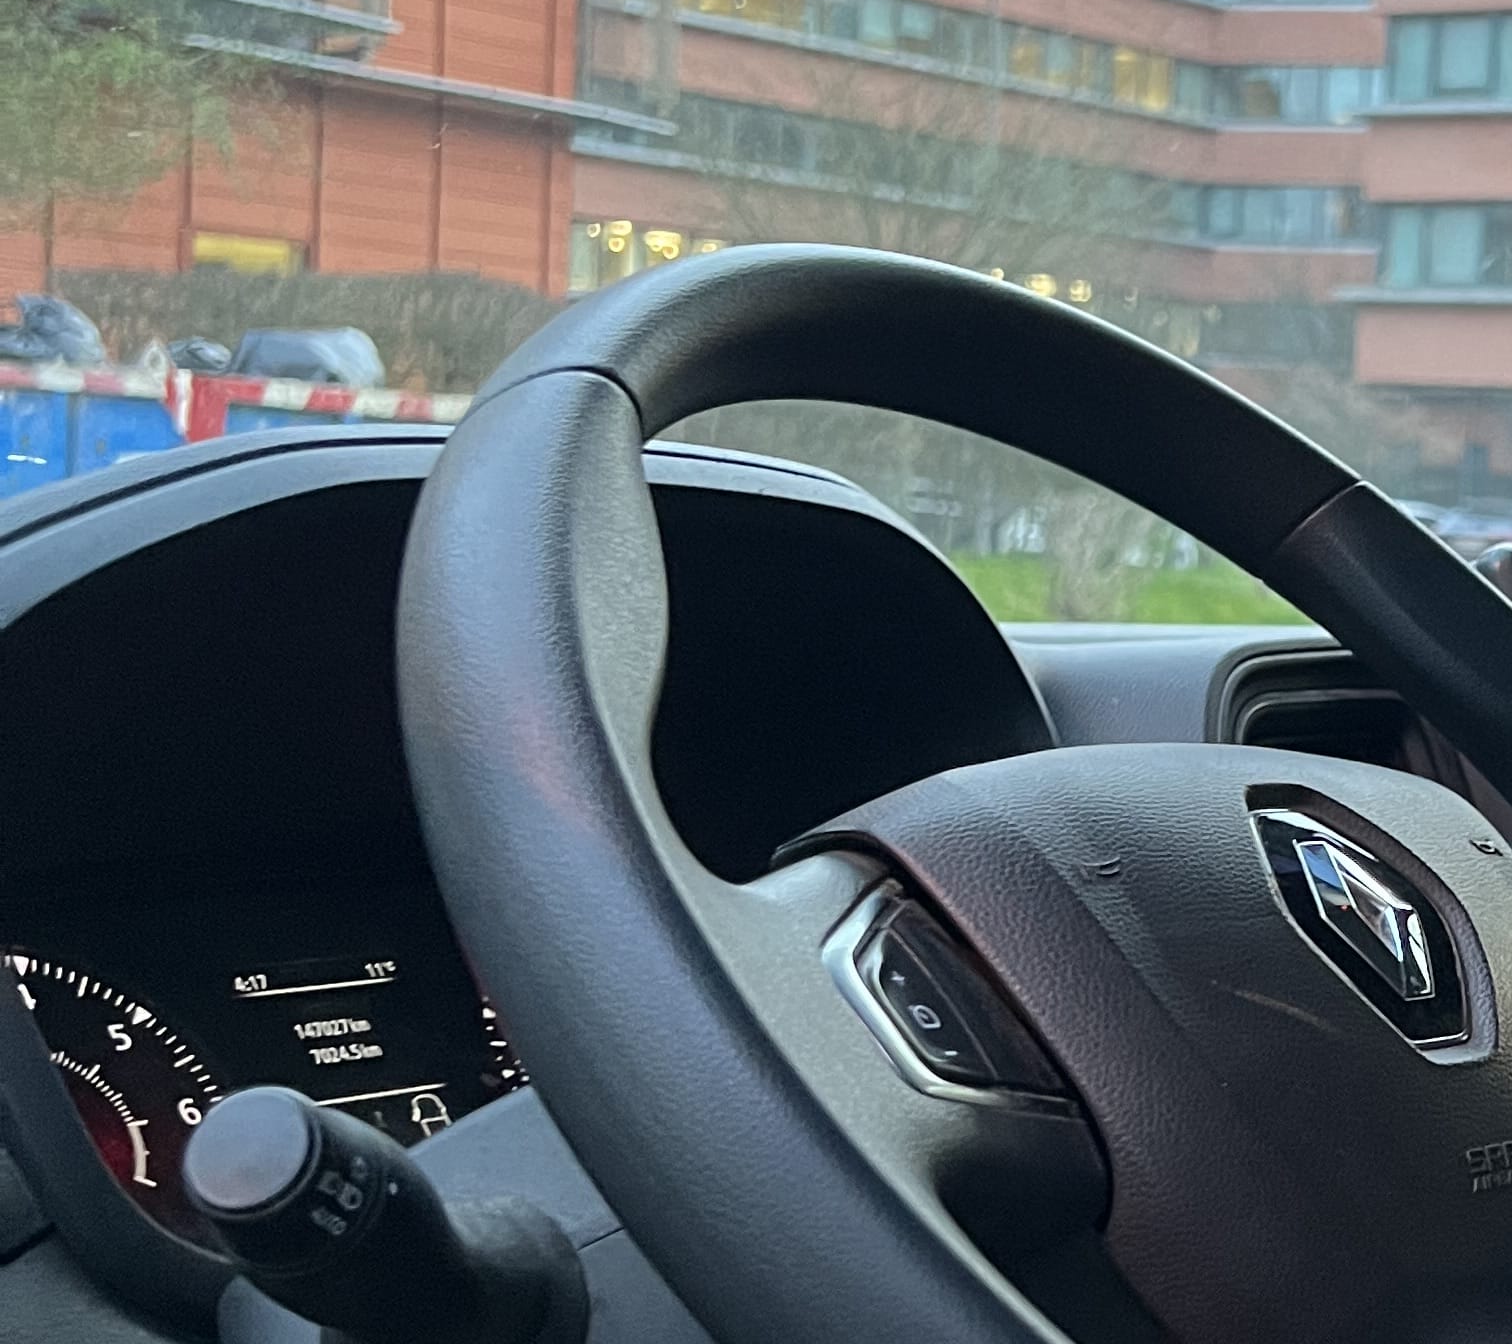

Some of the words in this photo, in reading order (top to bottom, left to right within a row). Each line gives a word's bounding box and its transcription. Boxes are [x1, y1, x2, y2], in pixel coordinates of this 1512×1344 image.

[234, 974, 267, 992] 4:17
[107, 1023, 132, 1051] 5
[177, 1098, 202, 1125] 6
